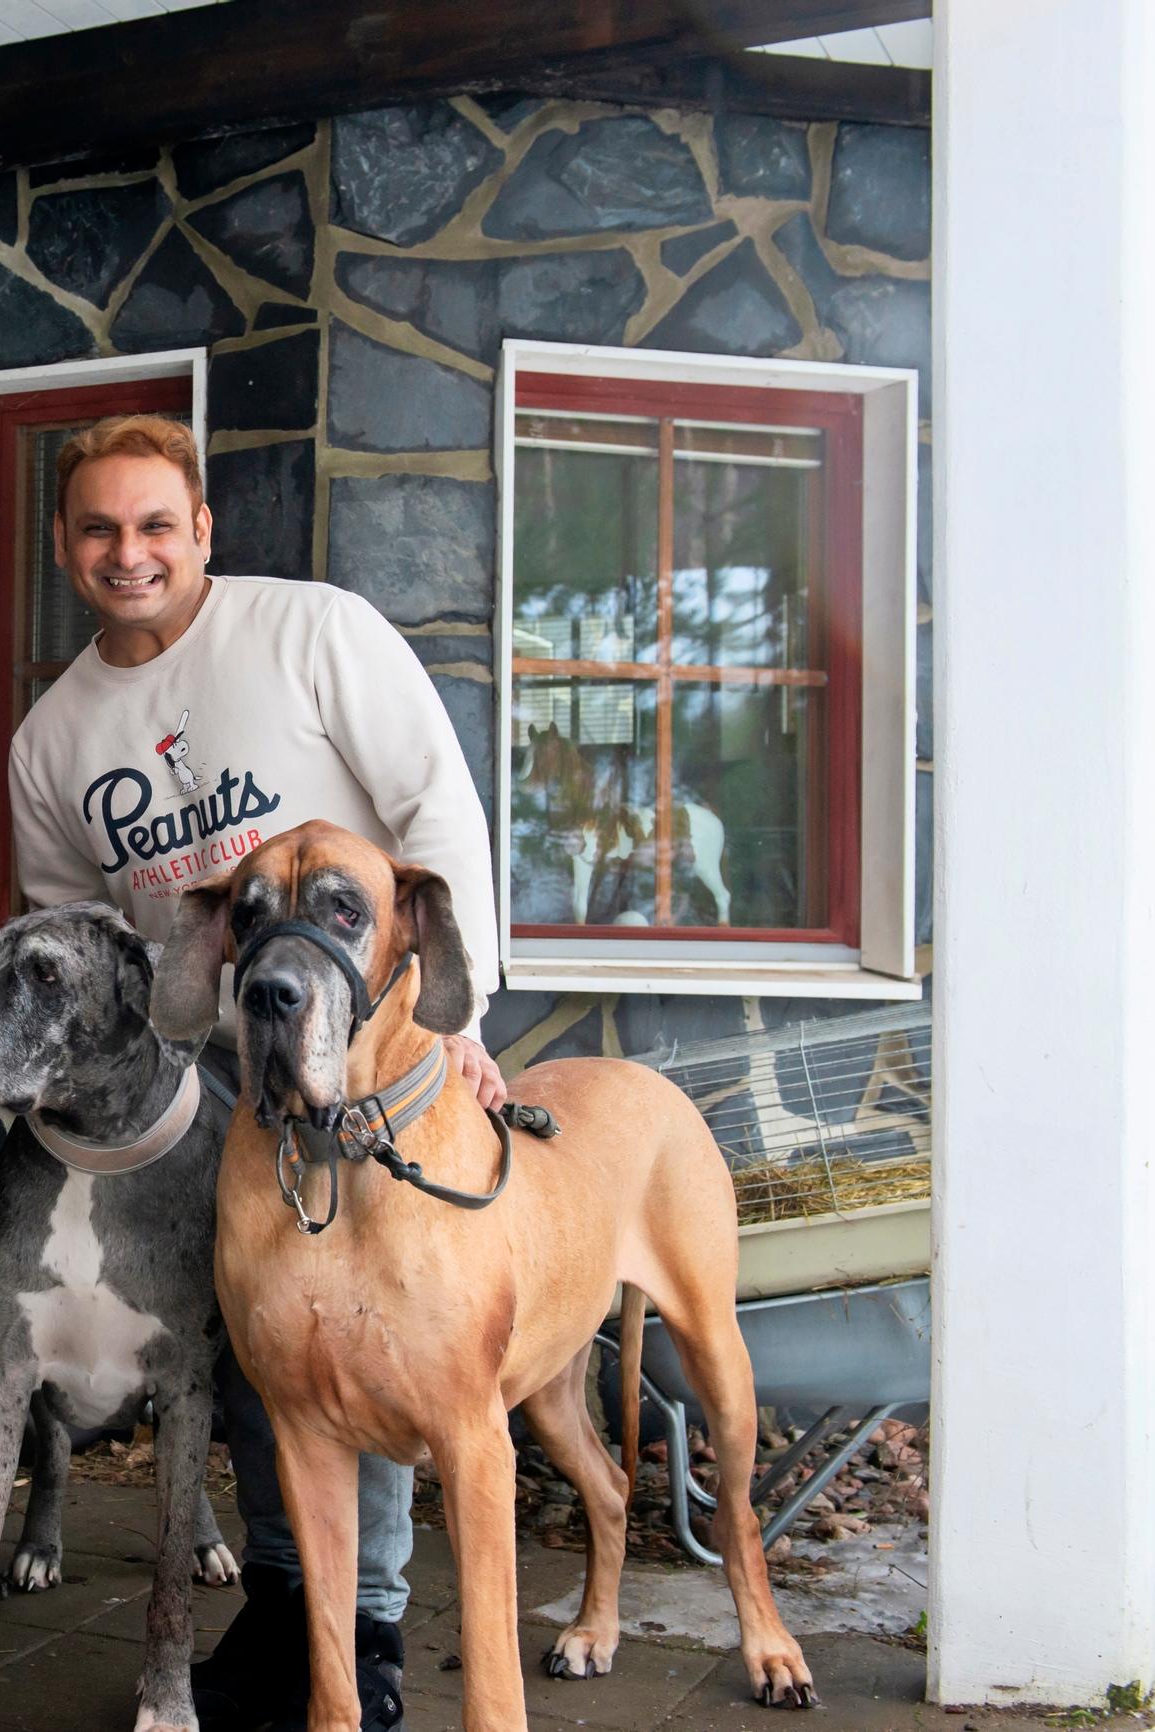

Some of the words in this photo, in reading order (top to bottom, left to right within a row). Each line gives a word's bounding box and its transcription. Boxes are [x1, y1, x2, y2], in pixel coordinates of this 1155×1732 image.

[83, 767, 281, 874] Peanuts
[133, 848, 208, 891] ATHLETIC
[210, 829, 263, 865] CLUB
[149, 888, 171, 899] NEW
